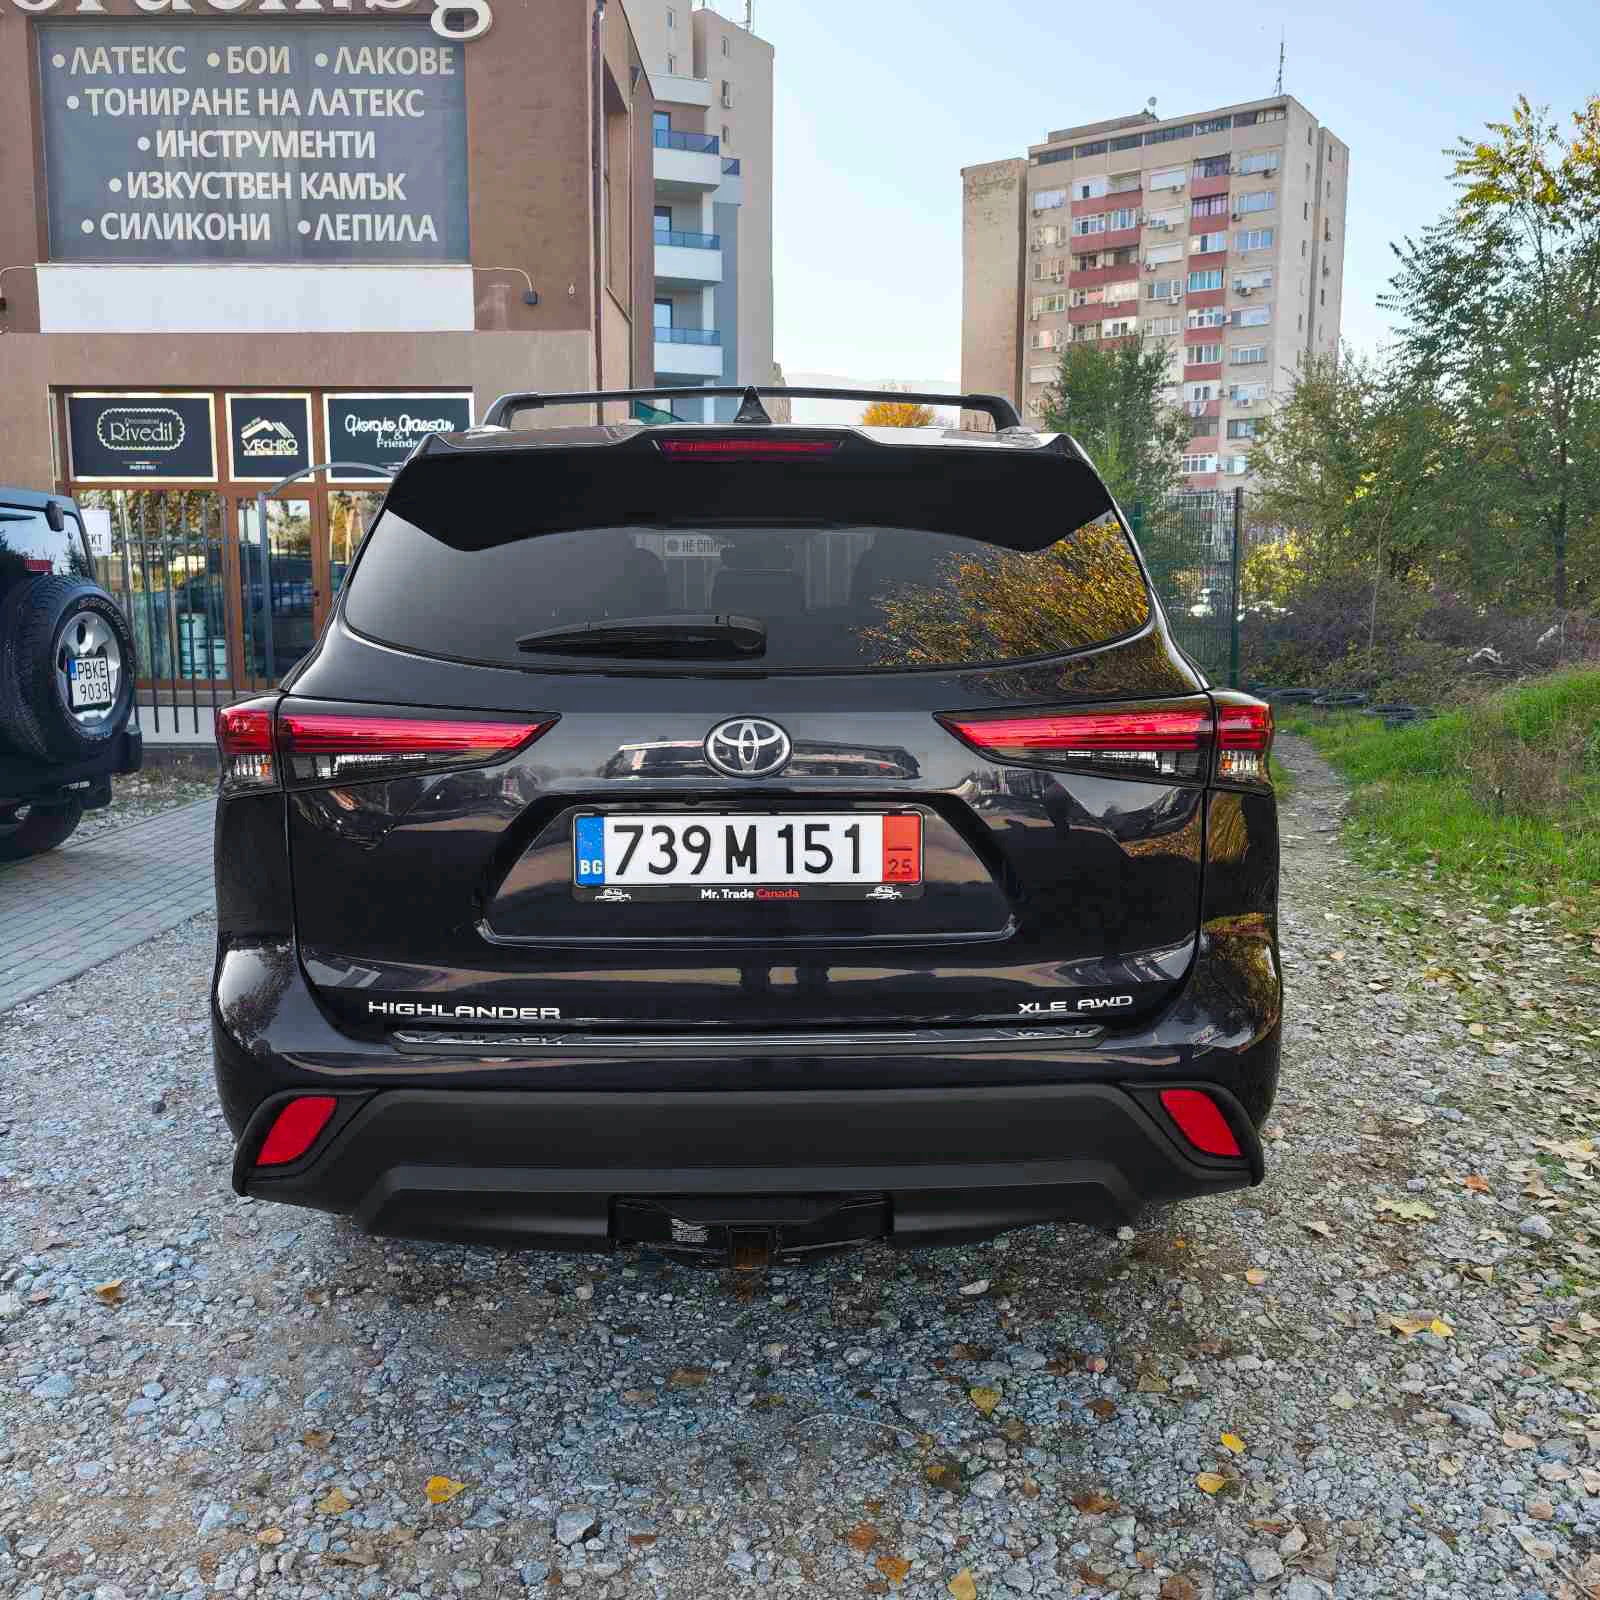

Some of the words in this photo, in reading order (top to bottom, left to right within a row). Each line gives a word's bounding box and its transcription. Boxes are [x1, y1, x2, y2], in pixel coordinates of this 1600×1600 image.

[70, 46, 186, 74] ЛАТЕКС
[226, 46, 291, 75] БОИ
[334, 46, 456, 75] ЛАКОВЕ
[84, 87, 251, 117] ТОНИРАНЕ
[258, 88, 301, 117] НА
[307, 88, 425, 118] ЛАТЕКС
[155, 129, 376, 159] ИНСТРУМЕНТИ
[127, 171, 290, 201] ИЗКУСТВЕН
[300, 172, 408, 202] КАМЪК
[100, 212, 271, 241] СИЛИКОНИ
[314, 213, 438, 242] ЛЕПИЛА
[109, 421, 174, 442] Rivedil
[79, 681, 108, 703] 9039
[612, 823, 712, 876] 739
[725, 823, 758, 875] M
[777, 823, 861, 875] 151
[579, 859, 603, 875] BG
[887, 858, 913, 875] 25
[700, 888, 720, 899] Mr.
[721, 888, 755, 899] Trade
[756, 888, 801, 899] Canada
[367, 1001, 561, 1020] HIGHLANDER
[1018, 1000, 1068, 1015] XLE
[1077, 995, 1133, 1011] AWD
